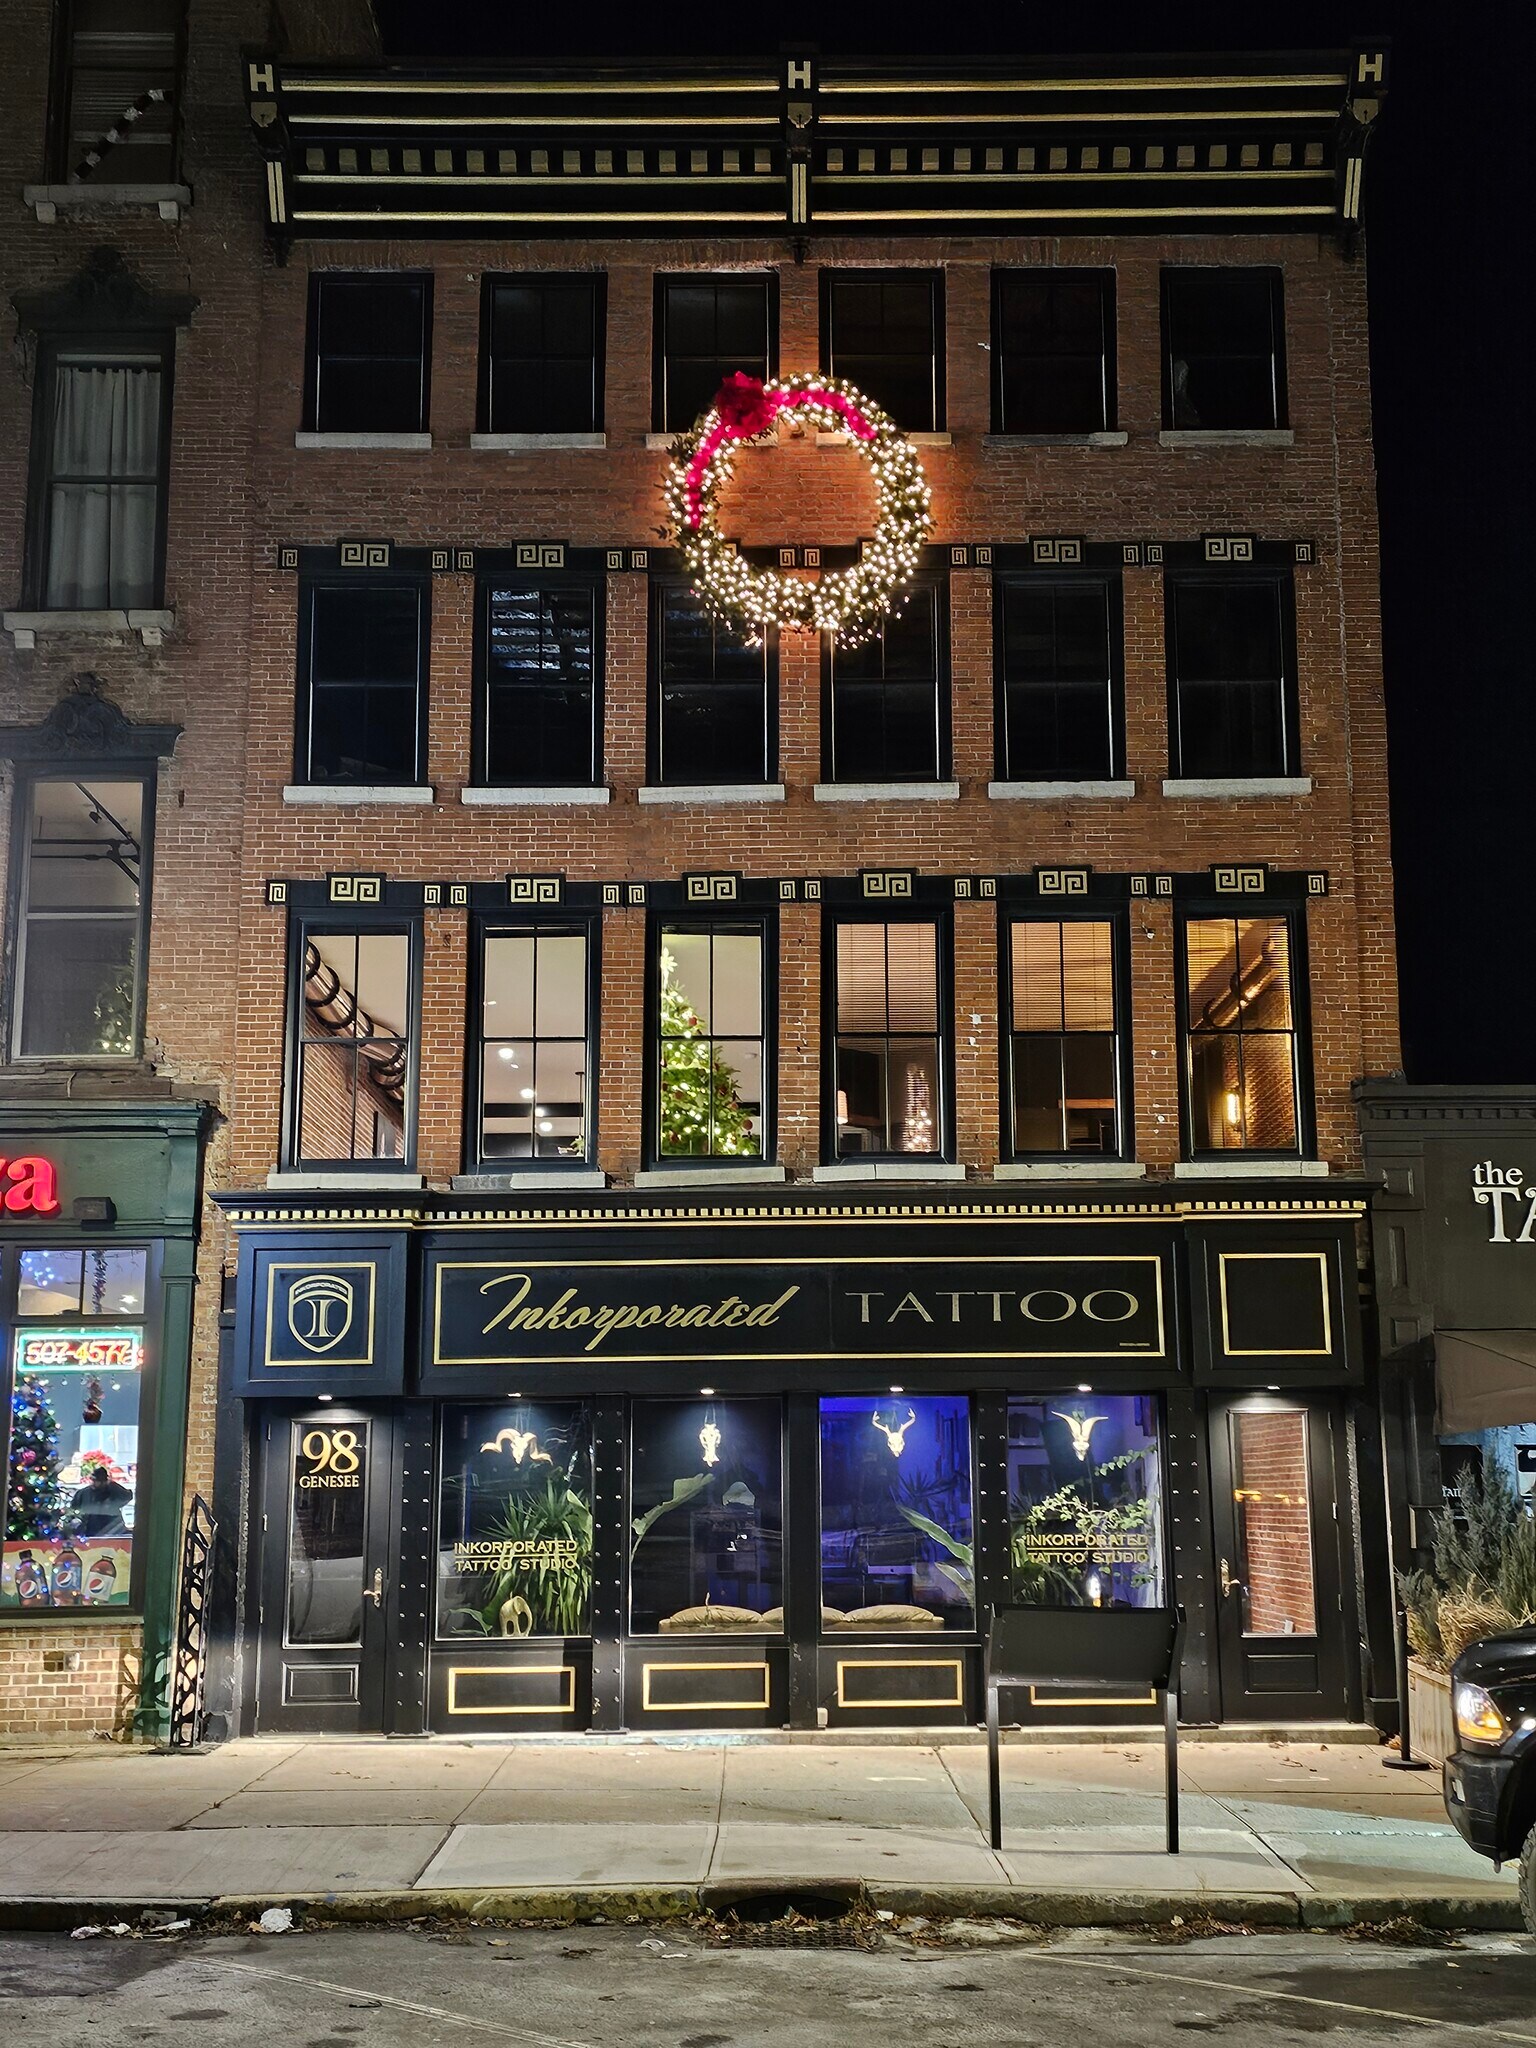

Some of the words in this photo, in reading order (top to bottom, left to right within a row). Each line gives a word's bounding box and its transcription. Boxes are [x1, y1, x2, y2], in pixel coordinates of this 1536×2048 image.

[249, 64, 274, 92] H
[788, 61, 811, 89] H
[1358, 54, 1383, 82] H
[0, 1157, 58, 1211] a
[1472, 1160, 1524, 1186] the
[479, 1273, 801, 1351] Inkorporated
[845, 1289, 1140, 1323] TATTOO
[302, 1430, 360, 1474] 98
[299, 1474, 360, 1489] GENESEE
[453, 1540, 578, 1555] INKORPORATED
[1026, 1533, 1149, 1547] INKORPORATED
[454, 1559, 512, 1572] TATTOO
[519, 1558, 577, 1571] STUDIO
[1027, 1551, 1086, 1564] TATTOO
[1092, 1551, 1149, 1564] STUDIO
